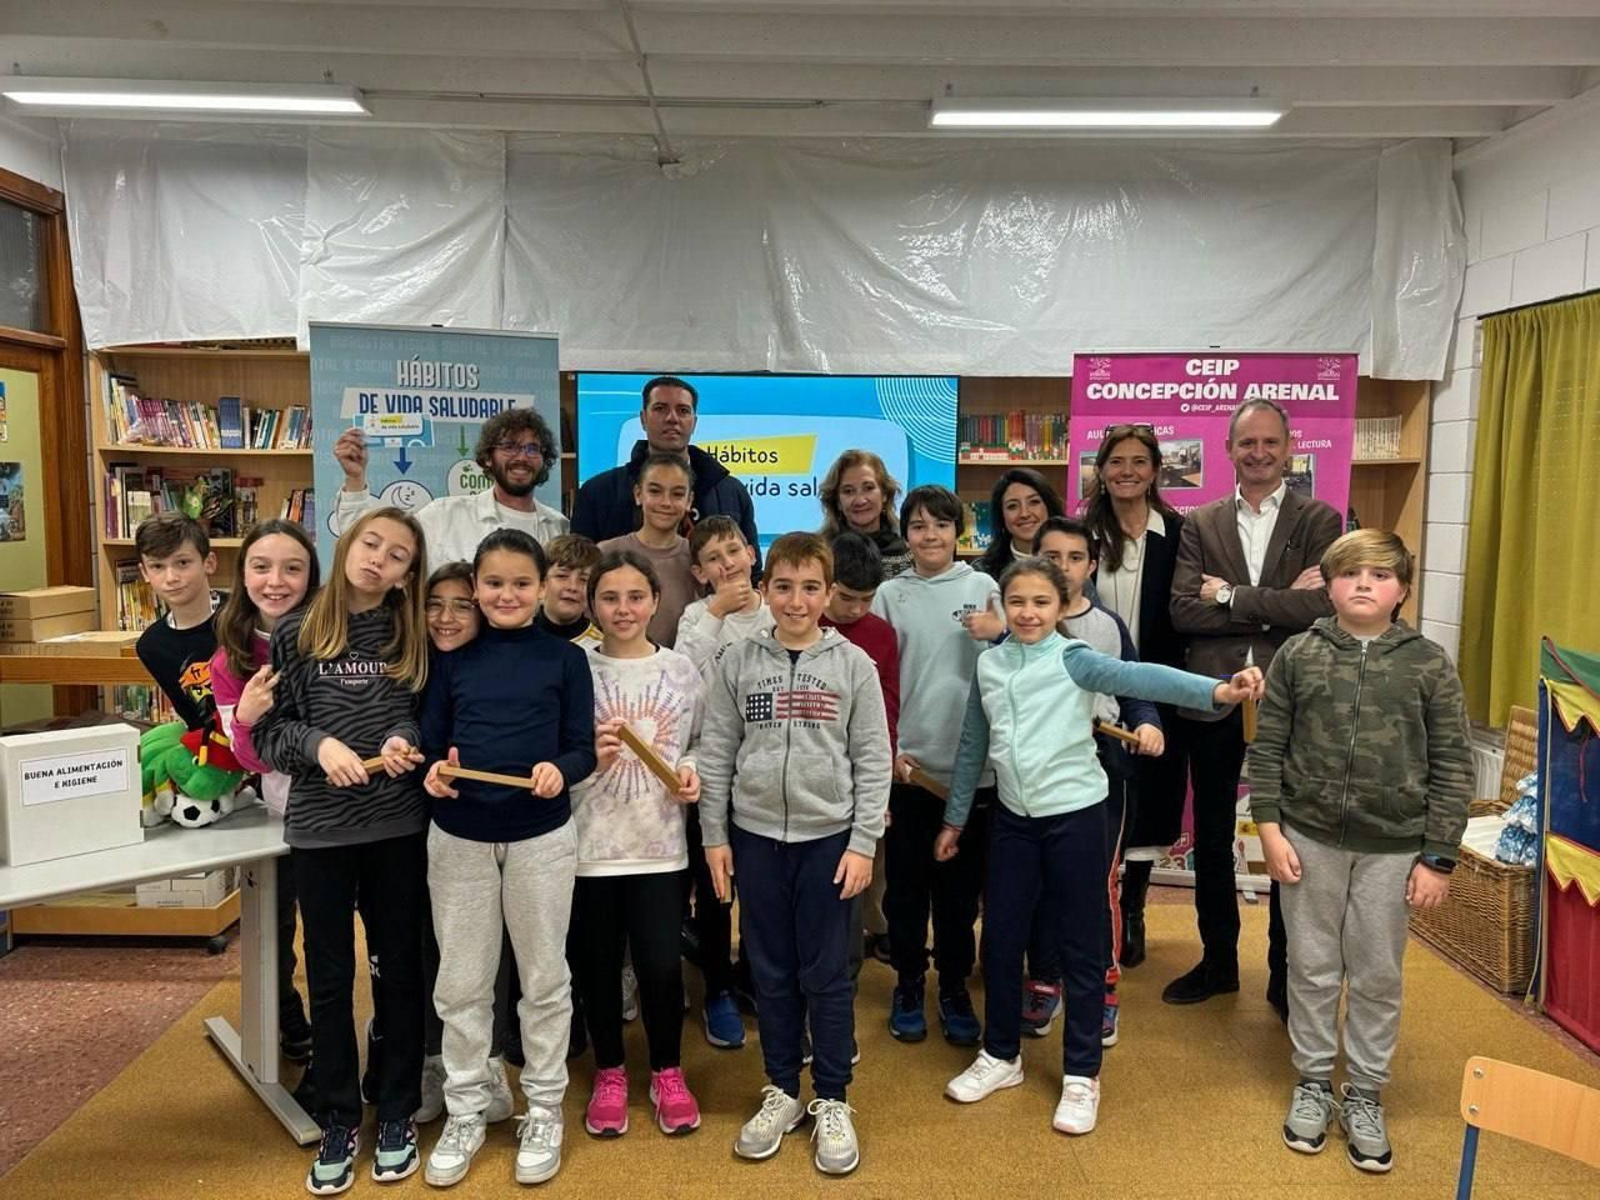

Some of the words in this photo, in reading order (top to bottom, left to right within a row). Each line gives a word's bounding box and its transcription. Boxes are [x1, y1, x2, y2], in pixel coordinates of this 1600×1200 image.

[396, 355, 480, 390] HÁBITOS
[1185, 359, 1240, 376] CEIP
[1086, 378, 1238, 400] CONCEPCIÓN
[1243, 383, 1340, 400] ARENAL
[358, 393, 379, 414] DE
[386, 394, 423, 414] VIDA
[707, 445, 779, 463] Hábitos
[1297, 439, 1332, 449] LECTURA
[745, 476, 781, 496] ida
[24, 769, 54, 781] BUENA
[56, 760, 123, 776] ALIMENTACIÓN
[54, 780, 59, 789] E
[62, 776, 98, 787] HIGIENE
